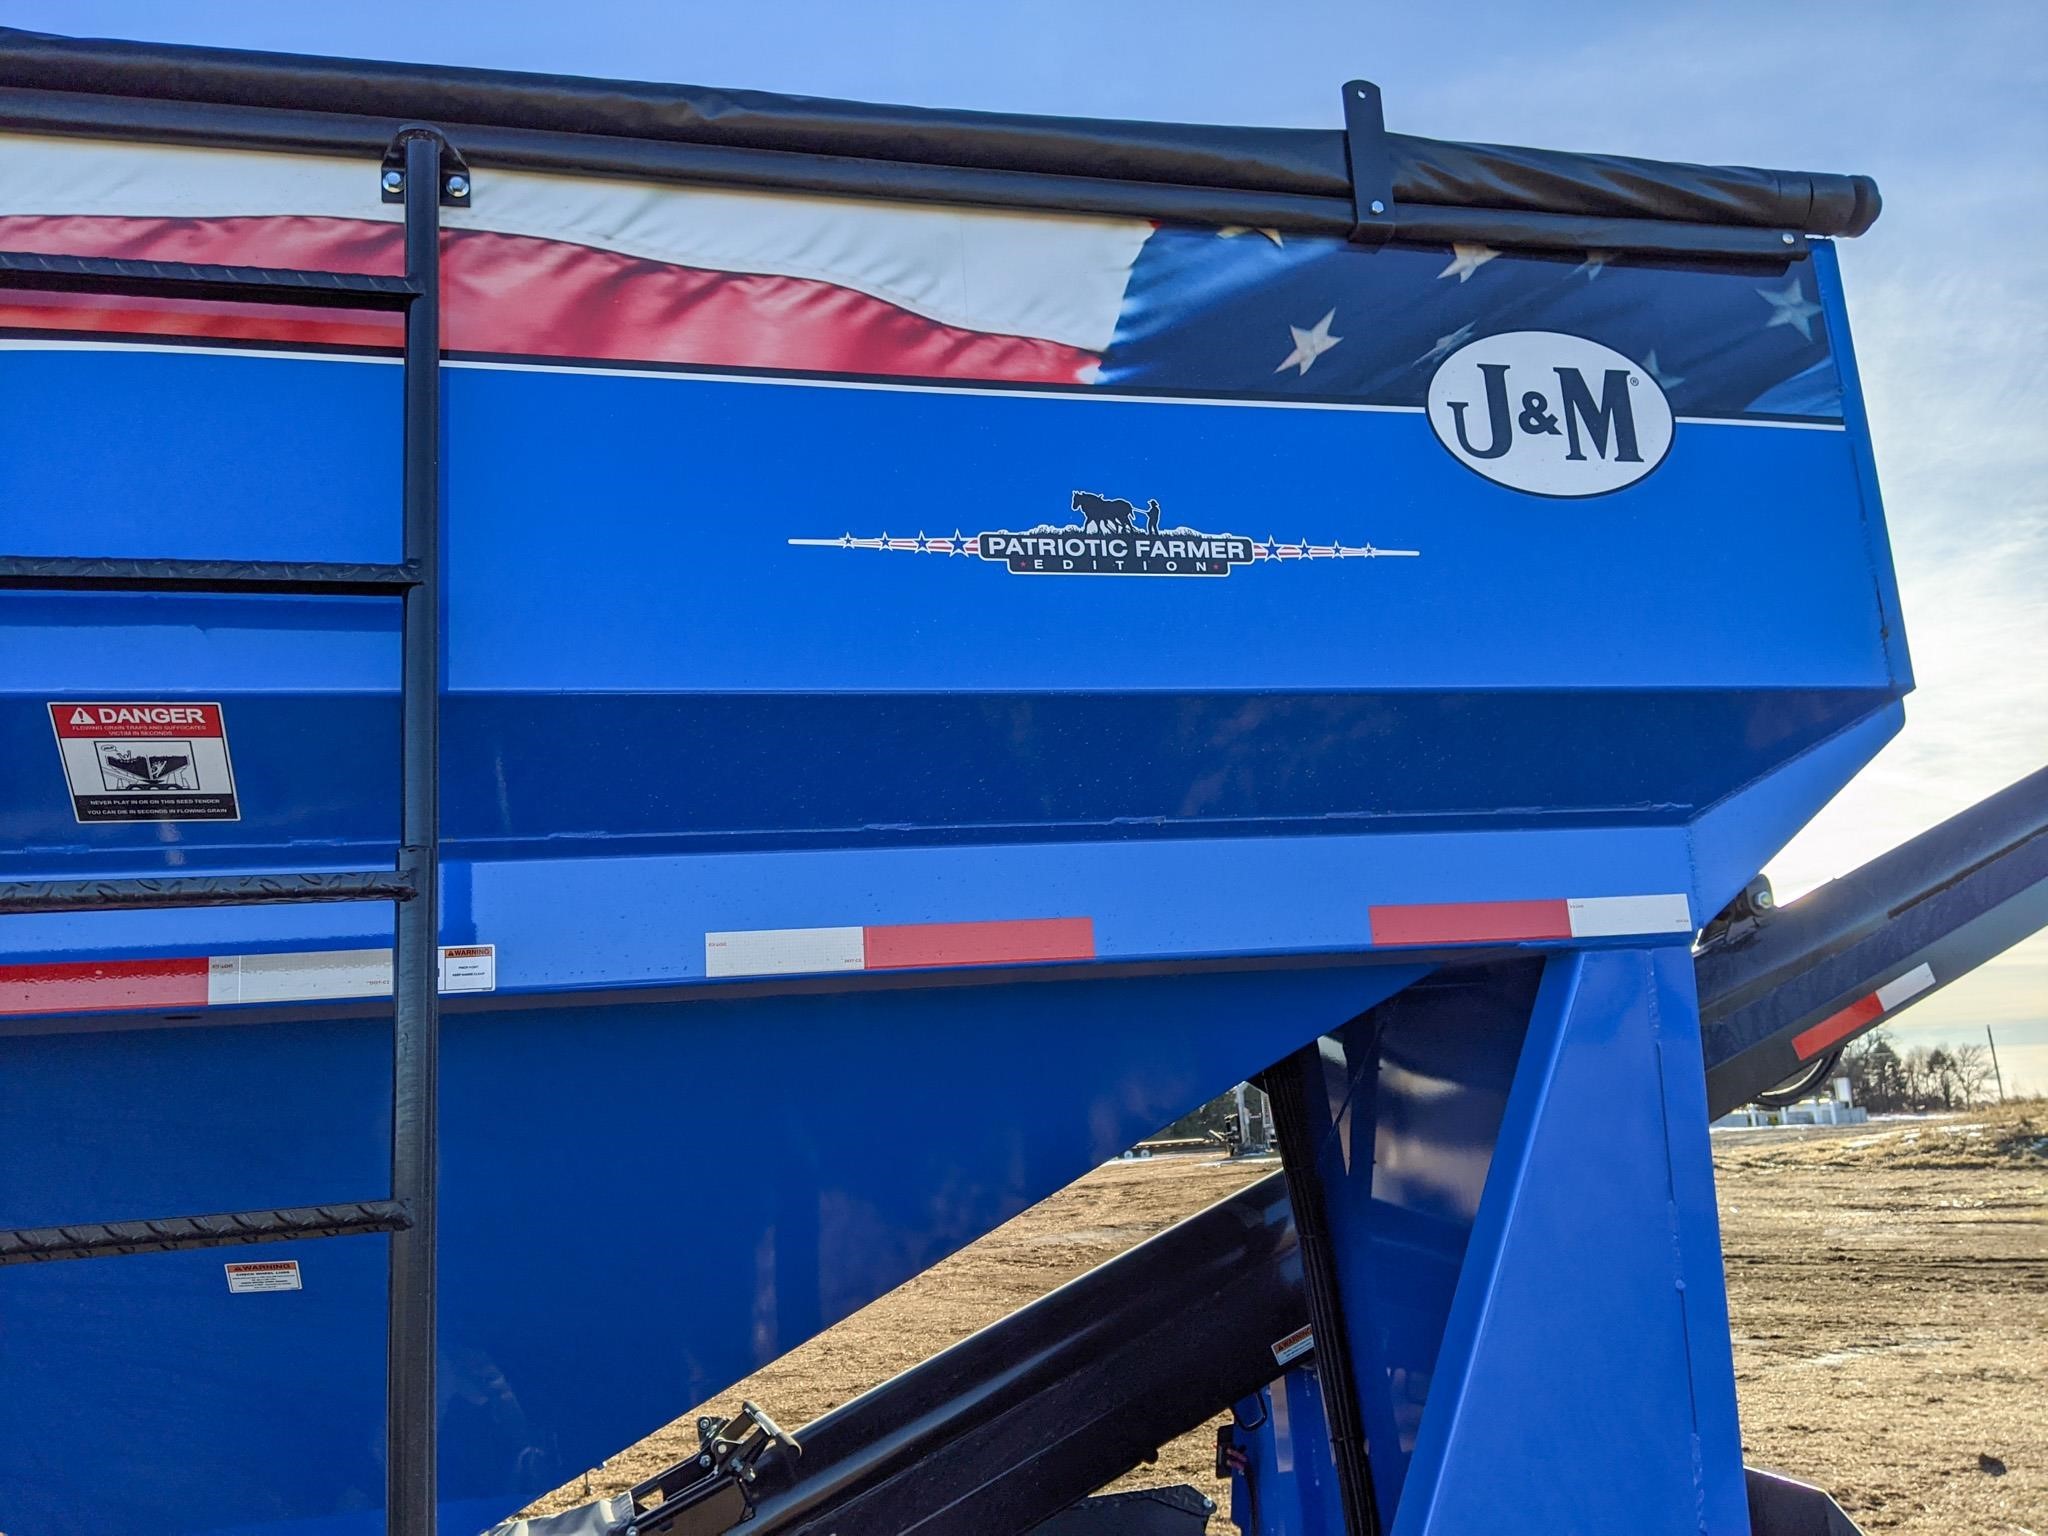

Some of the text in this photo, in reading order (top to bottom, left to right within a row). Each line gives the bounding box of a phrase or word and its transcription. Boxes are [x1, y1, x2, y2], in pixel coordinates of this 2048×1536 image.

[1446, 363, 1645, 463] J&M
[987, 538, 1246, 560] PATRIOTIC FARMER
[1033, 559, 1208, 572] EDITION
[98, 708, 206, 724] DANGER
[454, 948, 490, 956] WARNING
[242, 1263, 291, 1271] WARNING
